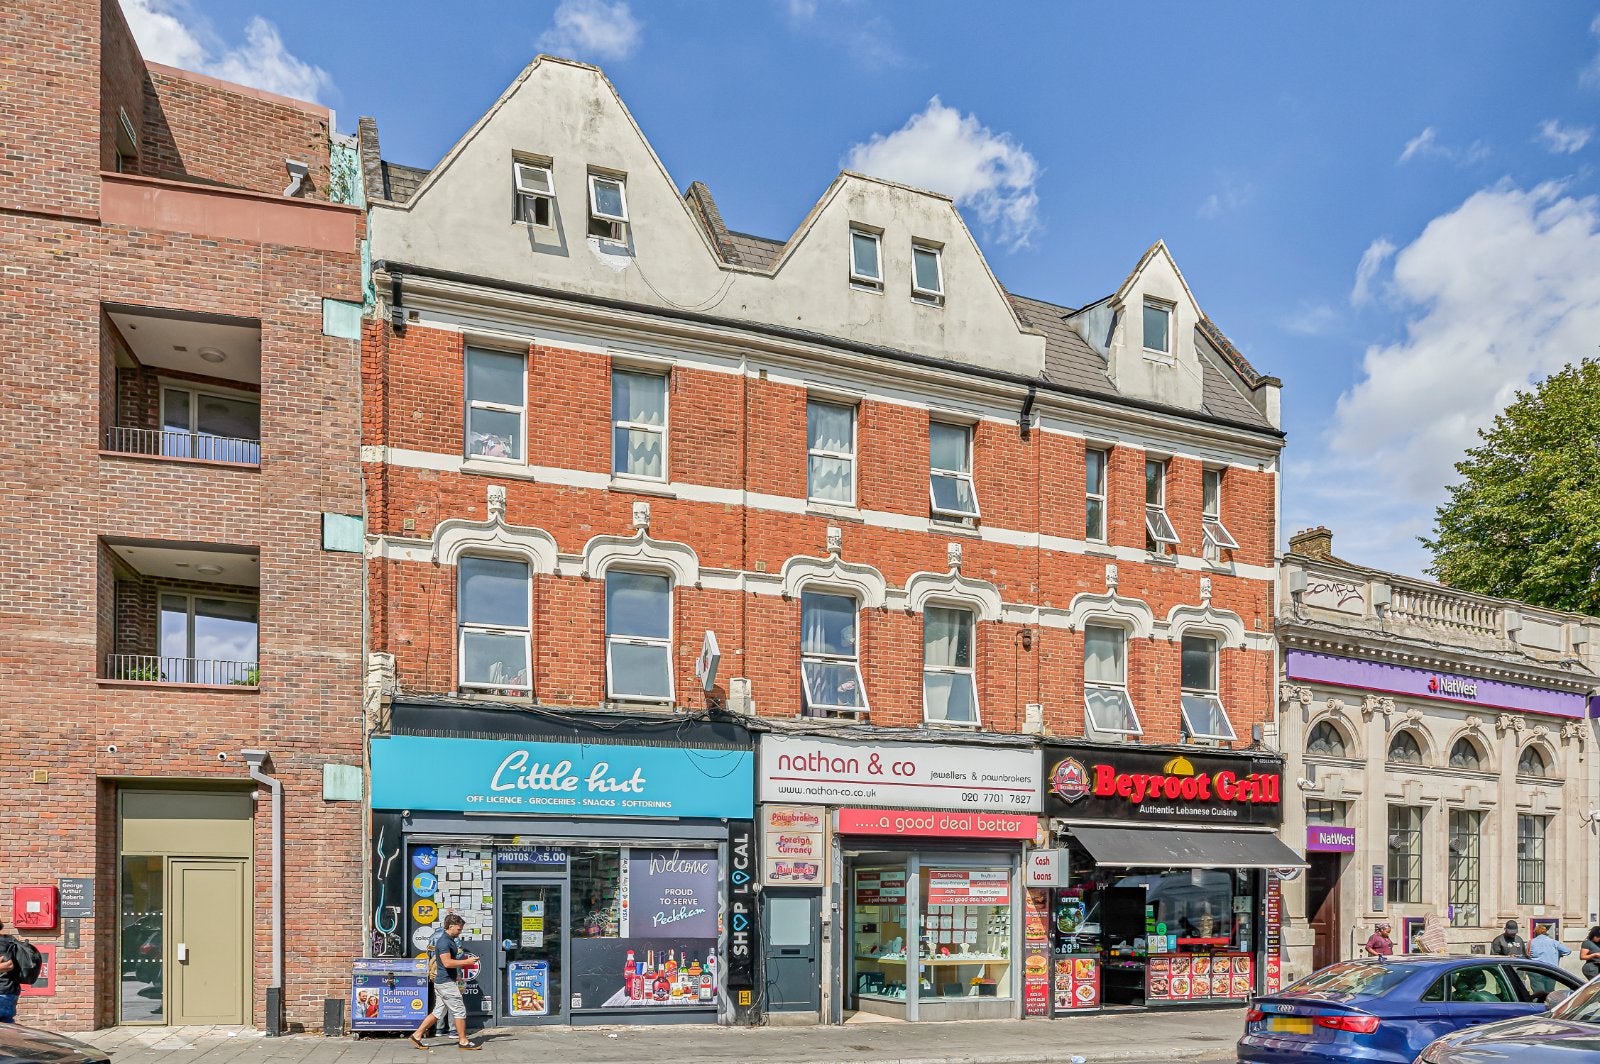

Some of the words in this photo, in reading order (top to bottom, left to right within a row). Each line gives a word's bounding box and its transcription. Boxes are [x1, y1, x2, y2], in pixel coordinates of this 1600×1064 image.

[1440, 677, 1478, 696] NatWest
[779, 751, 859, 774] nathan
[867, 753, 883, 775] &
[892, 761, 916, 777] co
[490, 750, 579, 791] Little
[584, 762, 647, 792] hut
[930, 770, 967, 780] jewellers
[971, 772, 978, 781] &
[981, 774, 1032, 783] pawnbrokers
[1094, 764, 1211, 804] Beyroot
[1216, 771, 1281, 802] Grill
[779, 786, 877, 798] www.nathan-co.co.uk
[961, 792, 979, 802] 020
[983, 793, 1004, 803] 7701
[1009, 794, 1031, 804] 7827
[466, 795, 484, 803] OFF
[486, 795, 523, 804] LICENCE
[529, 797, 576, 806] GROCERIES
[582, 798, 616, 807] SNACKS
[621, 799, 672, 808] SOFTDRINKS
[1139, 805, 1174, 815] Authentic
[1176, 806, 1210, 816] Lebanese
[1211, 808, 1238, 817] Cuisine
[772, 812, 819, 825] Pawnbroking
[895, 815, 934, 832] good
[940, 815, 972, 831] deal
[977, 816, 1022, 832] better
[780, 835, 811, 846] Foreign
[1320, 832, 1355, 846] NatWest
[498, 853, 529, 861] PHOTOS
[538, 853, 566, 861] £5.00
[778, 846, 812, 856] Currency
[649, 850, 710, 876] Welcome
[1035, 855, 1050, 866] Cash
[1033, 871, 1052, 881] Loans
[664, 888, 693, 896] PROUD
[652, 906, 706, 928] Peckham
[382, 996, 402, 1004] Data
